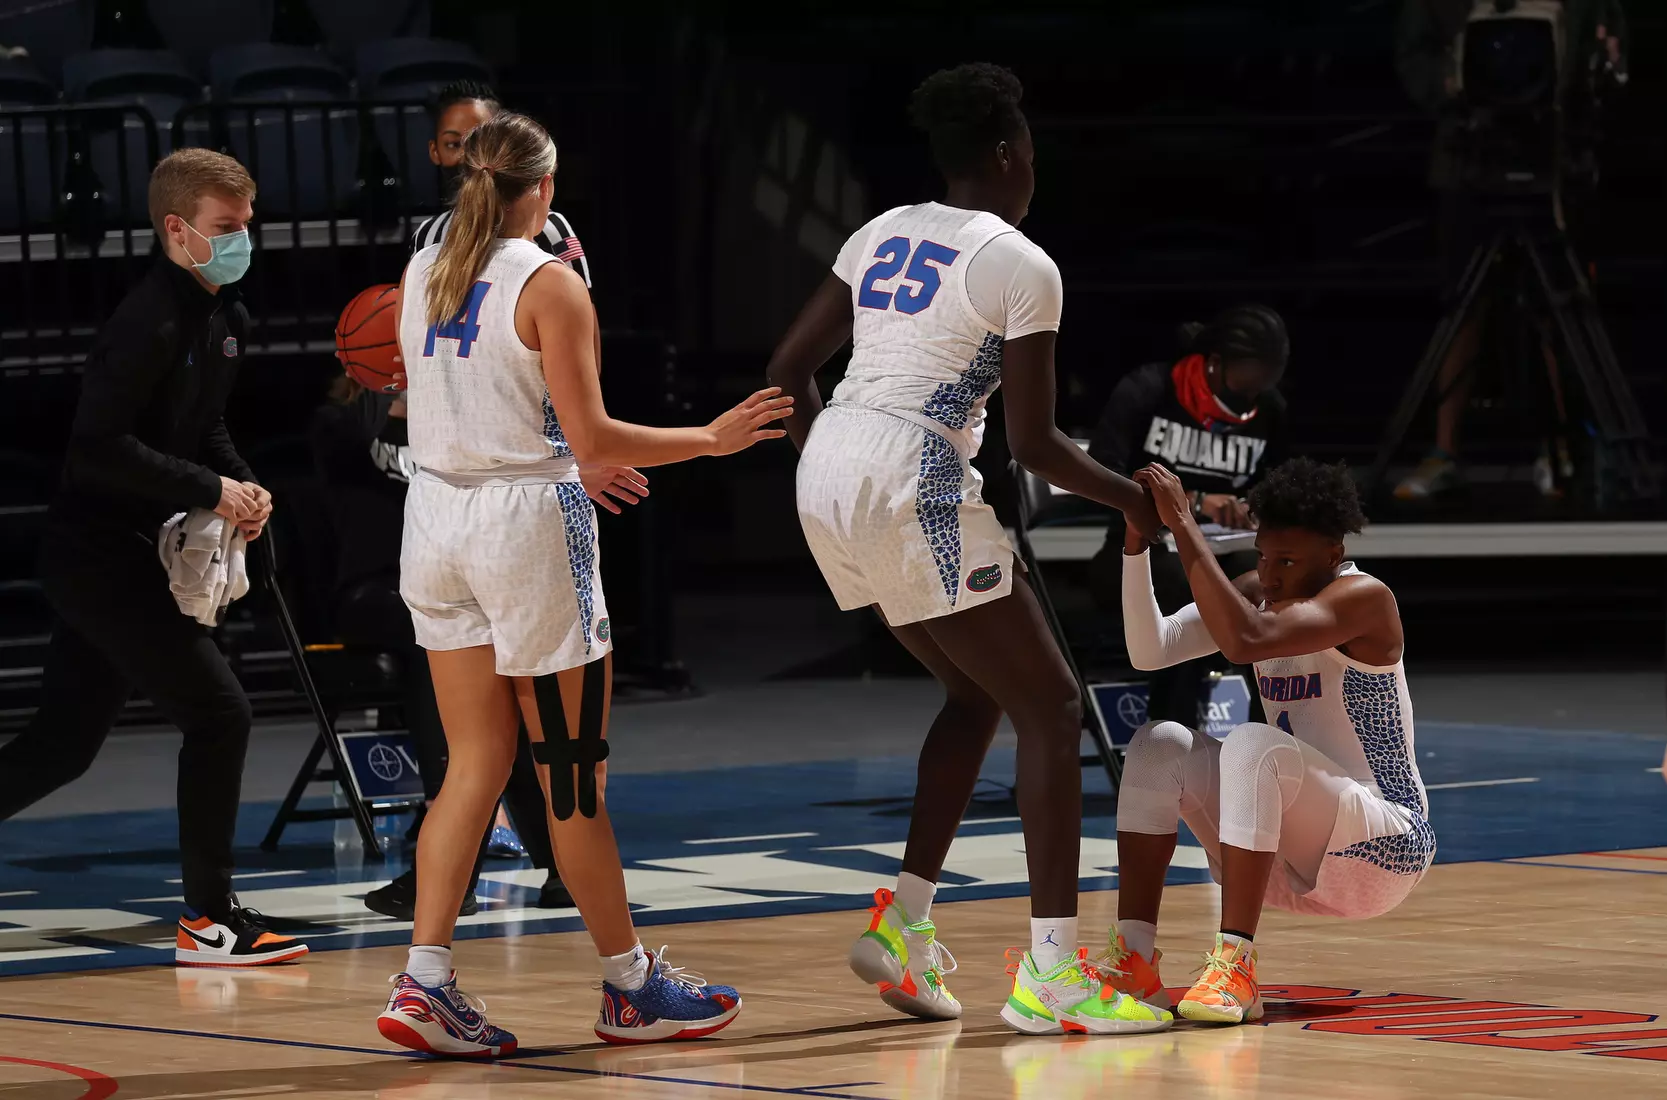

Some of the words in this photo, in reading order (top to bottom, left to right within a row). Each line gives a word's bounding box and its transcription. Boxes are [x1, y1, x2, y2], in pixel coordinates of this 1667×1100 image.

[858, 236, 960, 315] 25
[1143, 416, 1267, 475] EQUALITY
[1259, 673, 1322, 702] ORIDA
